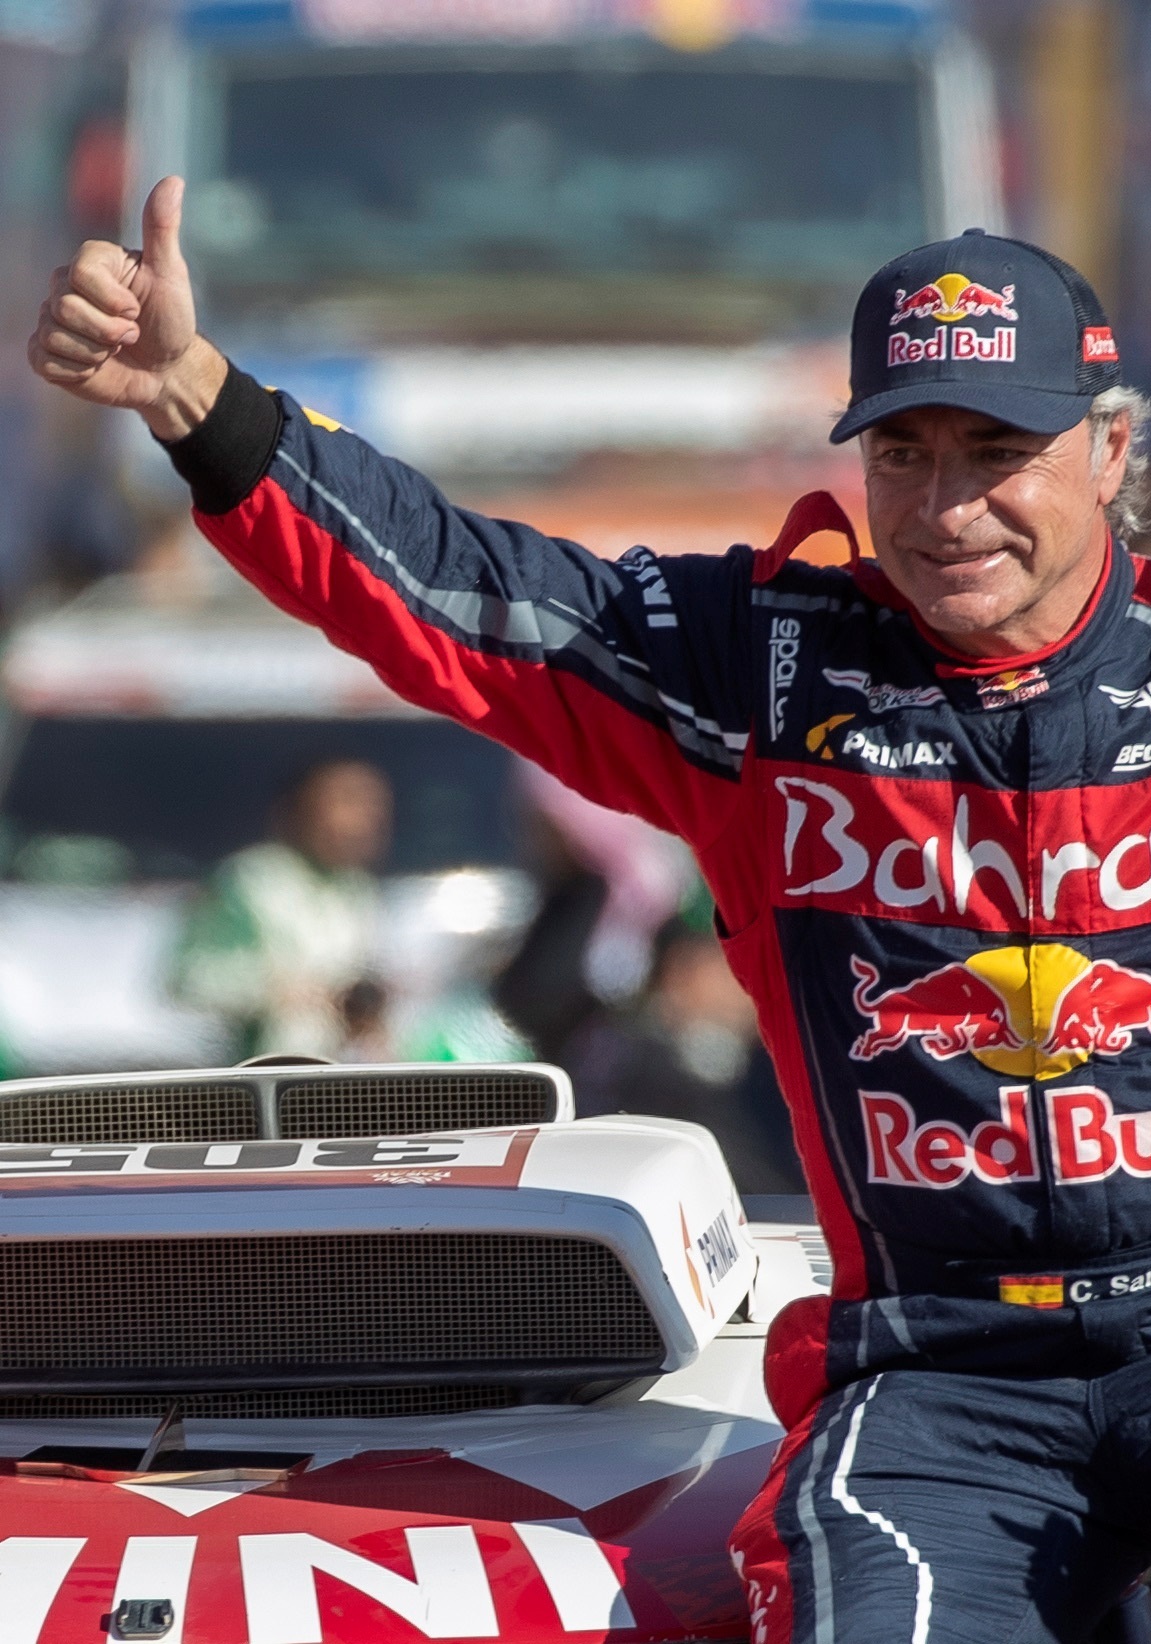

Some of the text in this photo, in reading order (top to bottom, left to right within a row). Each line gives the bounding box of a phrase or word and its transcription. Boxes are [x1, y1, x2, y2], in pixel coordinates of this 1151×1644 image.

[887, 325, 1017, 368] Red Bull
[842, 730, 958, 769] PRIMAX
[858, 1085, 1040, 1189] Red
[1069, 1279, 1100, 1303] C.
